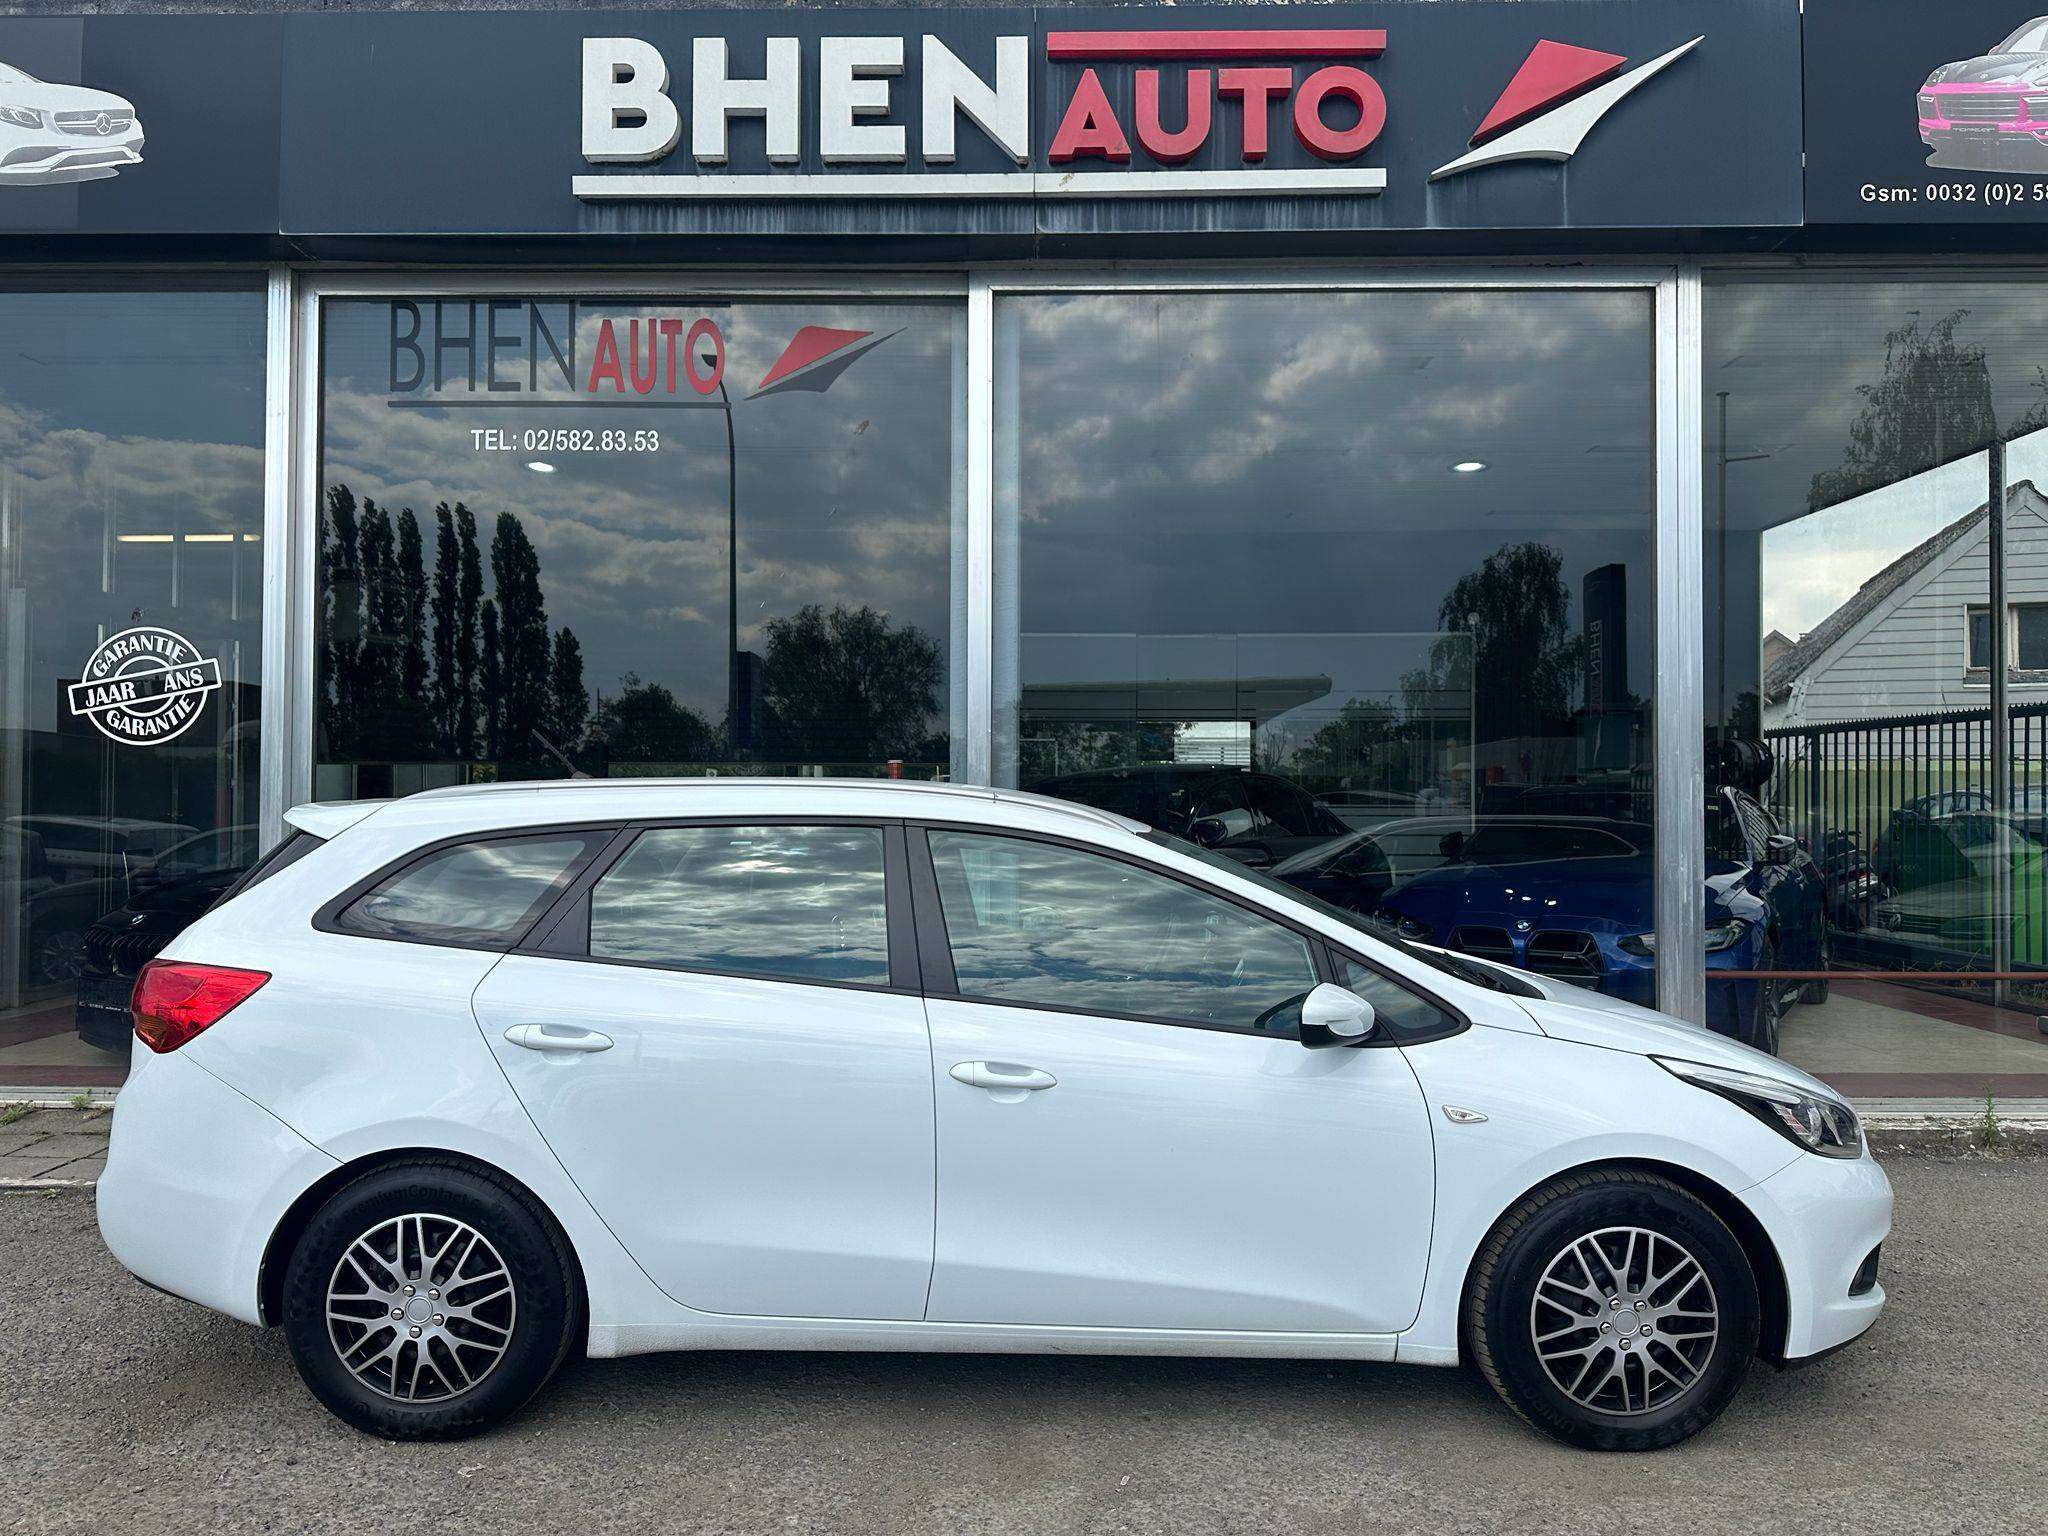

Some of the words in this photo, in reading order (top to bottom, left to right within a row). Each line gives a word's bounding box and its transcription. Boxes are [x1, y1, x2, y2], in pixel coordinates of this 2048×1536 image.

[582, 35, 1029, 165] BHEN
[1048, 66, 1386, 163] AUTO
[1860, 184, 1918, 202] Gsm:
[1925, 184, 1977, 202] 0032
[1984, 183, 2024, 205] (0)2
[2032, 183, 2048, 201] 5
[389, 298, 576, 392] BHEN
[588, 318, 725, 394] AUTO
[470, 429, 517, 451] TEL:
[524, 429, 660, 452] 02/582.83.53
[92, 635, 188, 678] GARANTIE
[85, 681, 136, 708] JAAR
[164, 667, 204, 692] ANS
[106, 694, 195, 736] GARANTIE
